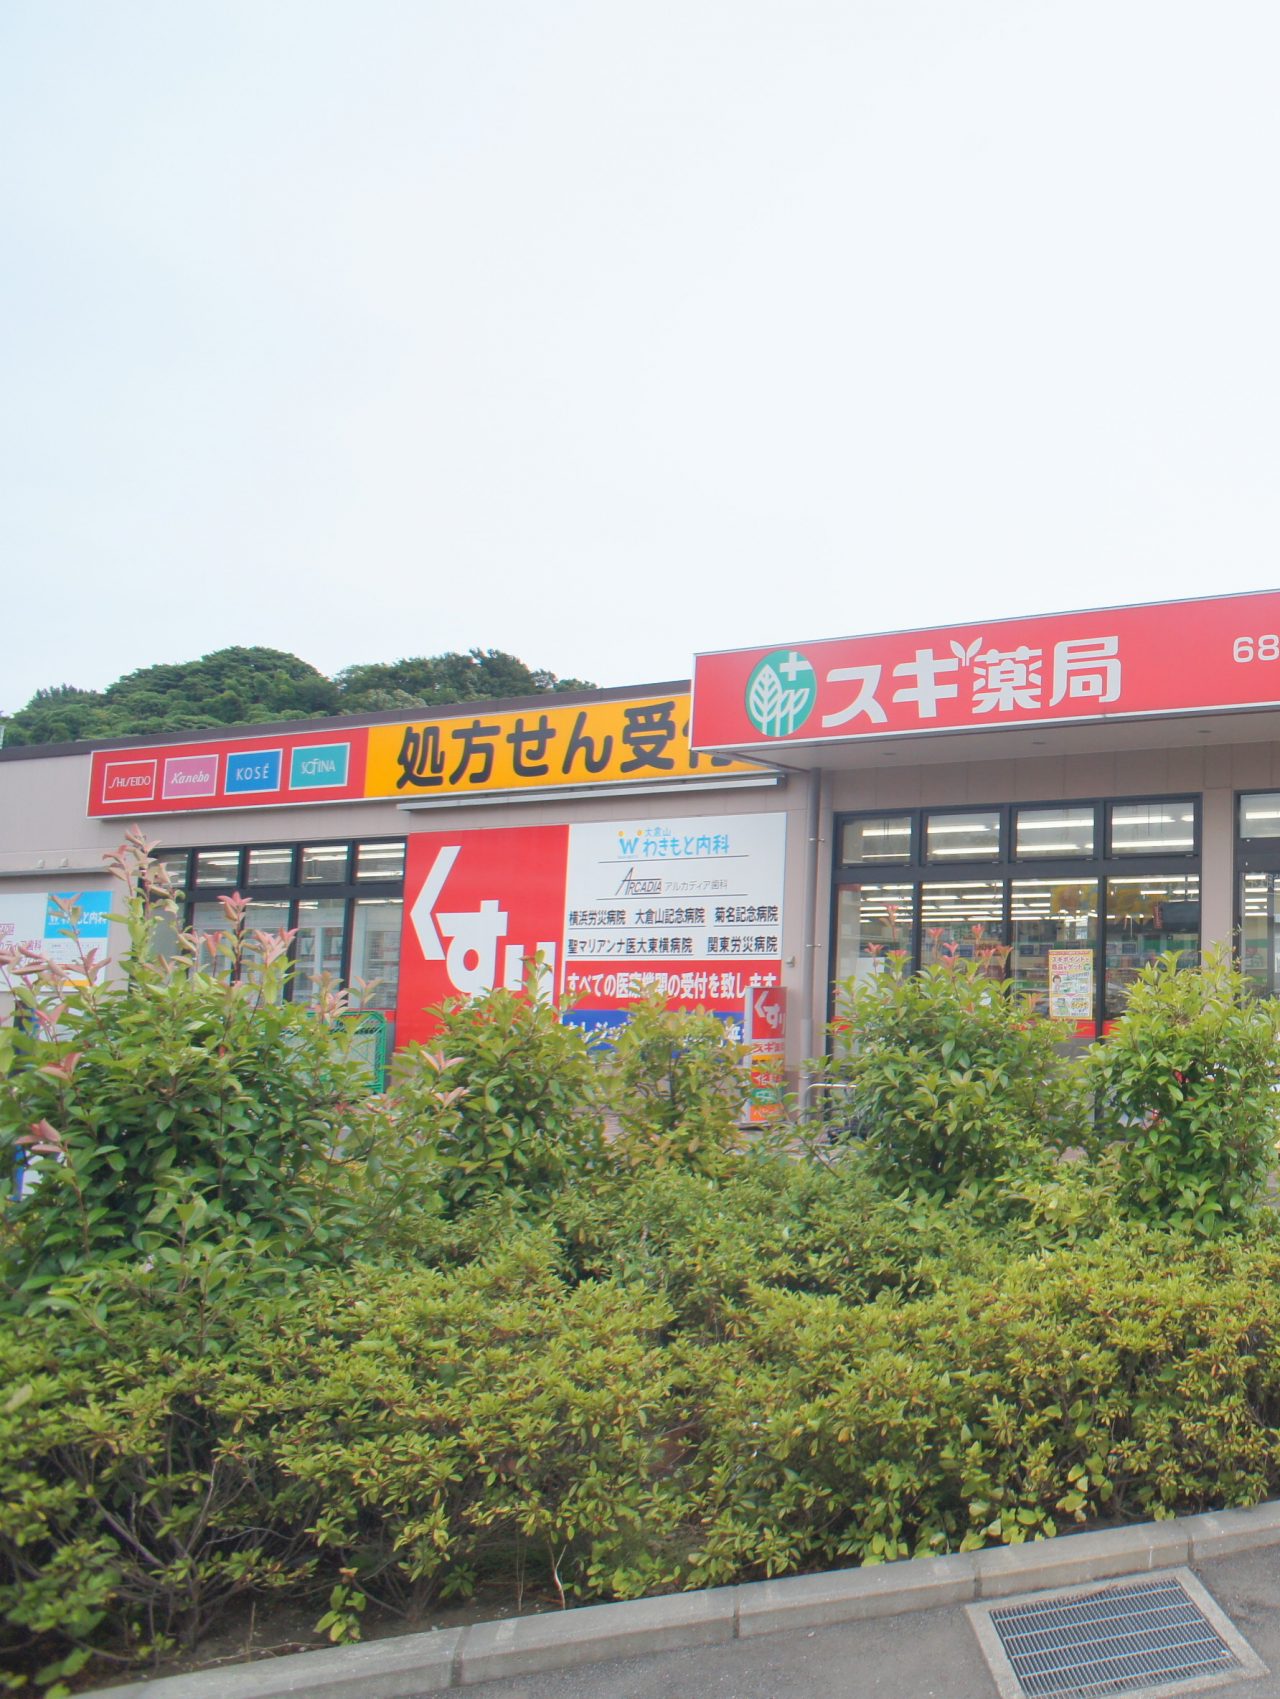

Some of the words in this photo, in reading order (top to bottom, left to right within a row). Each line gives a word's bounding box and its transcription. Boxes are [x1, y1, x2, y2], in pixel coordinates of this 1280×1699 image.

[821, 635, 1122, 729] スギ薬局
[171, 767, 210, 784] Kanebo
[236, 763, 270, 781] KOSÉ
[301, 758, 336, 776] SOFINA
[108, 775, 151, 789] SHISEIDO
[644, 827, 671, 837] 大倉山
[643, 834, 730, 857] わきもと内科
[615, 867, 661, 896] ARCADIA
[665, 879, 728, 892] アルカディア歯科
[569, 910, 626, 925] 横浜労災病院
[635, 908, 706, 924] 大倉山記念病院
[715, 905, 778, 923] 菊名記念病院
[410, 845, 556, 1011] くすり
[568, 937, 693, 954] 聖マリアンナ医大東横病院
[708, 936, 778, 953] 関東労災病院
